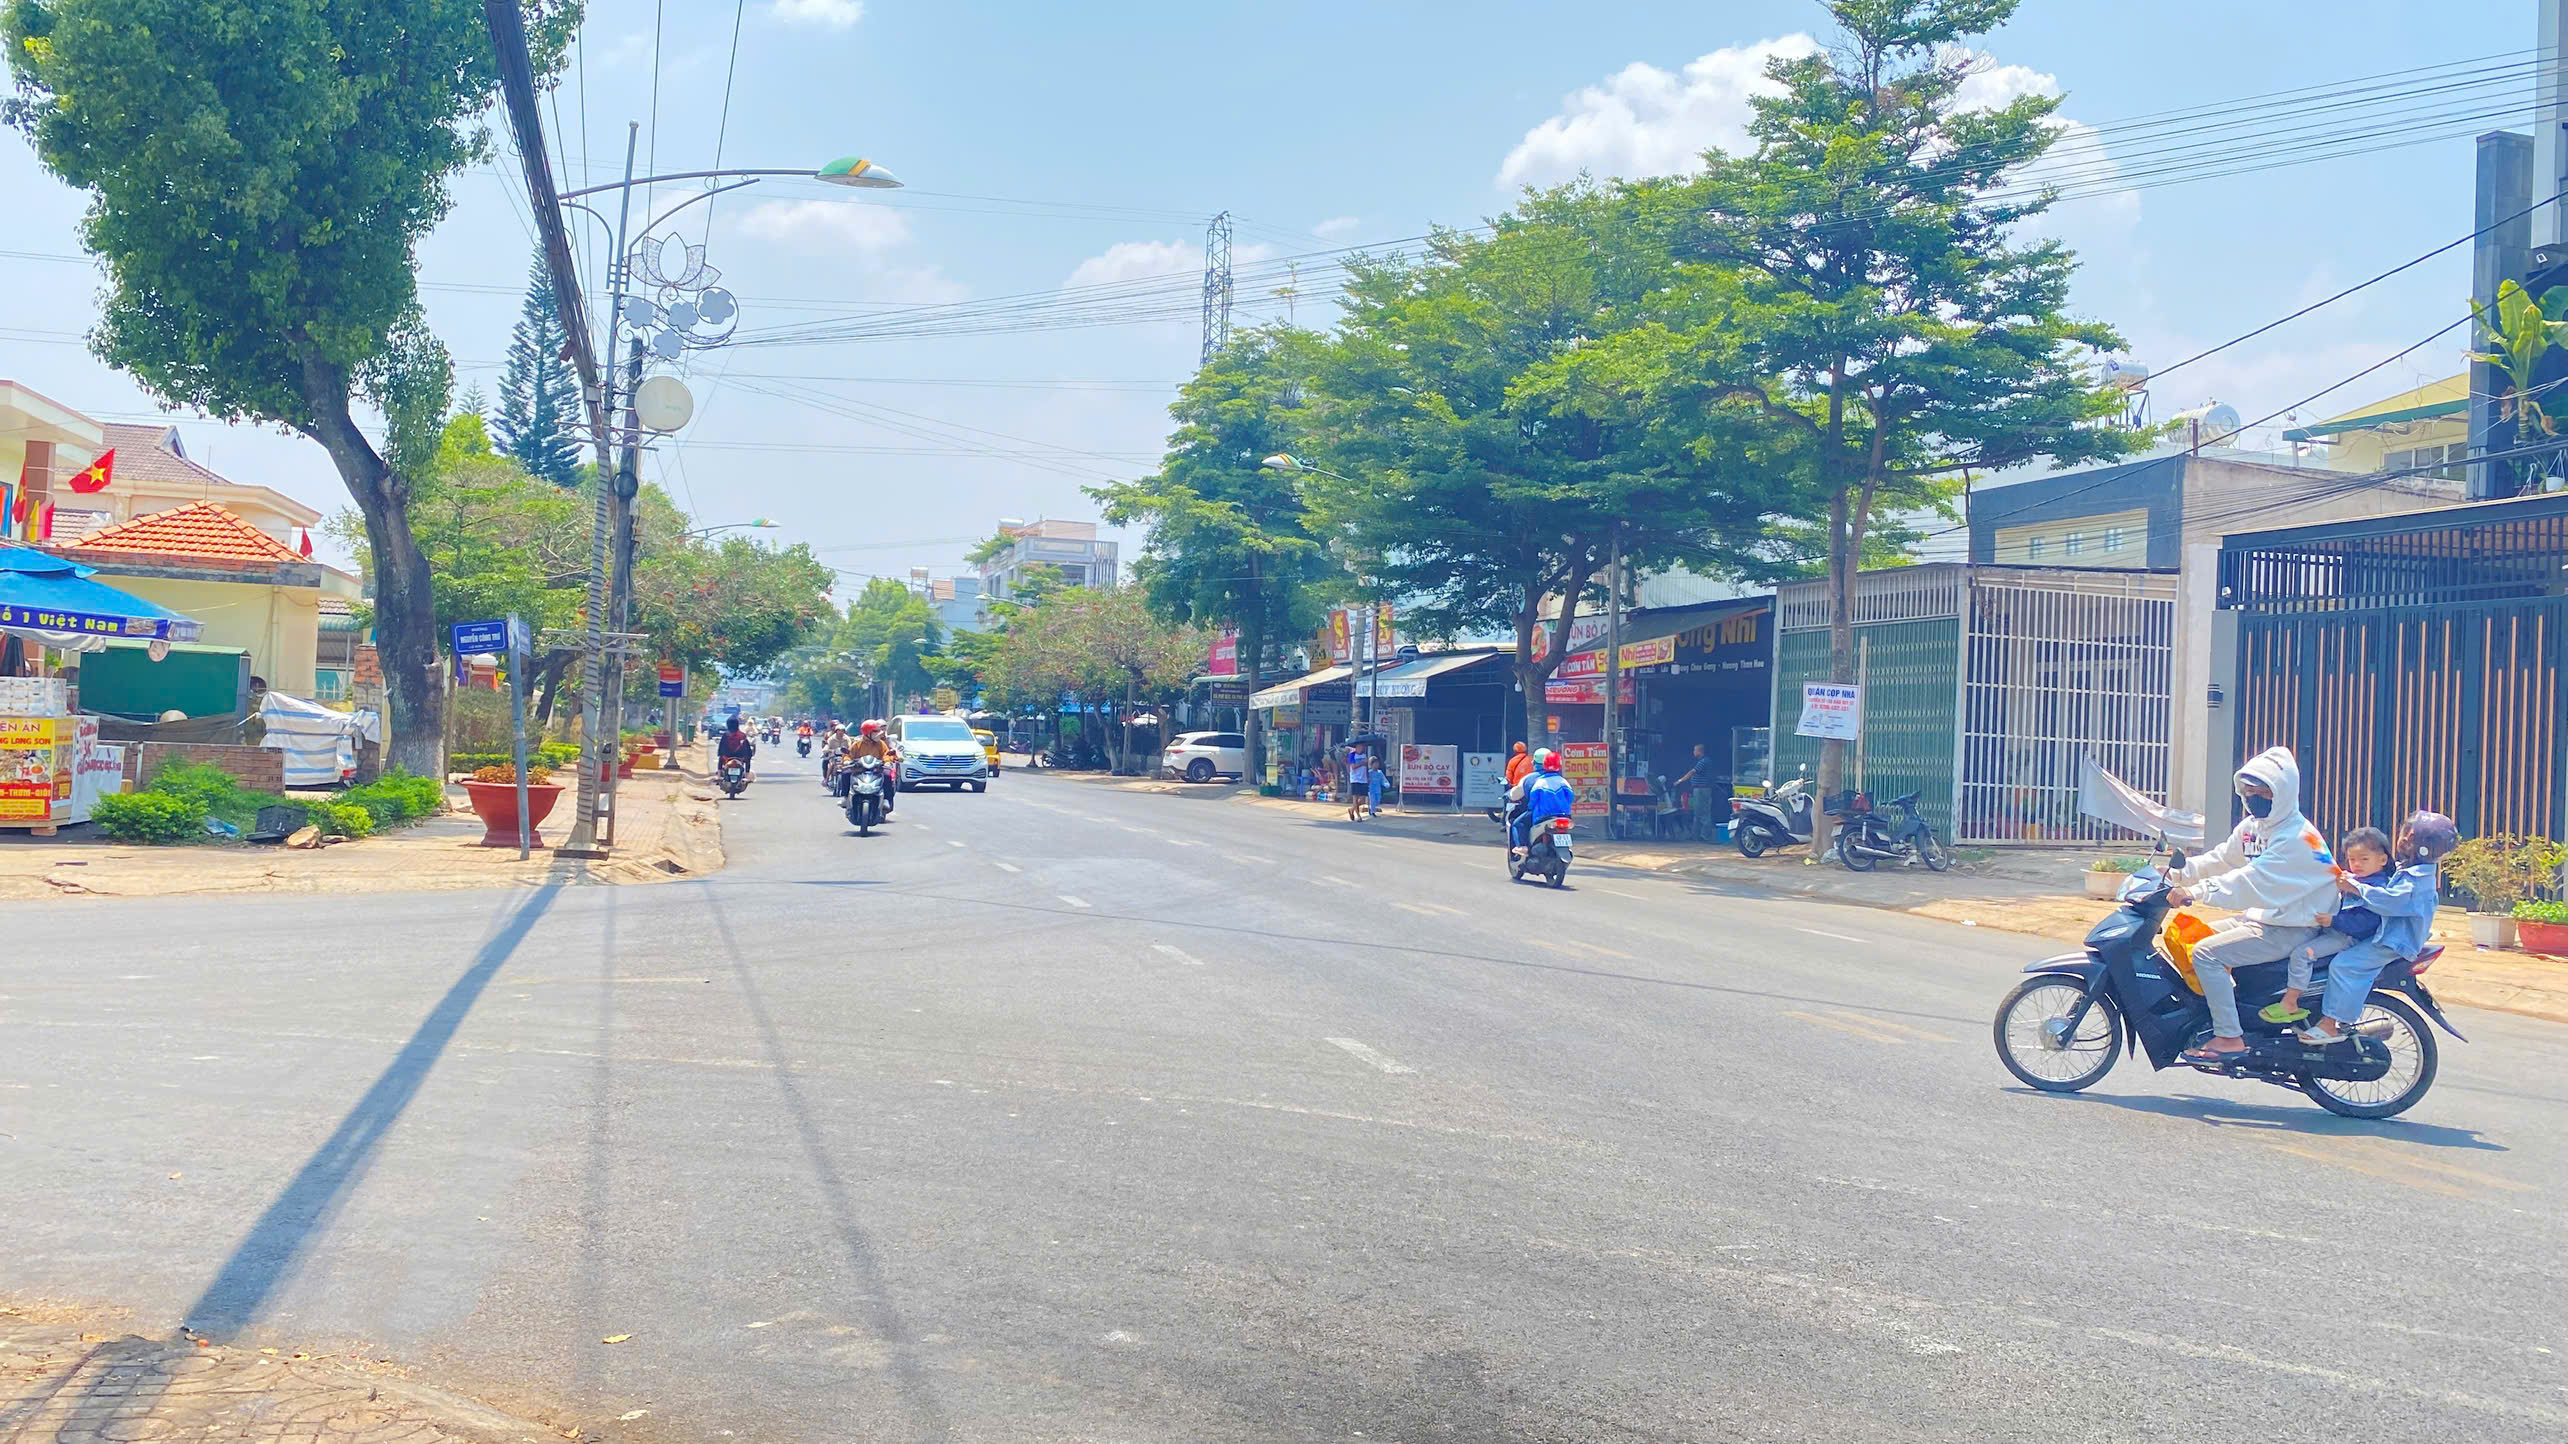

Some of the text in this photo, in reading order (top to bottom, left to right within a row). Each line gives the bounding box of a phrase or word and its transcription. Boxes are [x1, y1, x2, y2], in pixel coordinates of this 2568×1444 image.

[23, 612, 30, 623] 1
[39, 613, 77, 629] Việt
[85, 618, 118, 632] Nam
[1677, 624, 1715, 653] ong
[1808, 686, 1825, 696] QUÁN
[1565, 745, 1606, 757] Cơm Tấm
